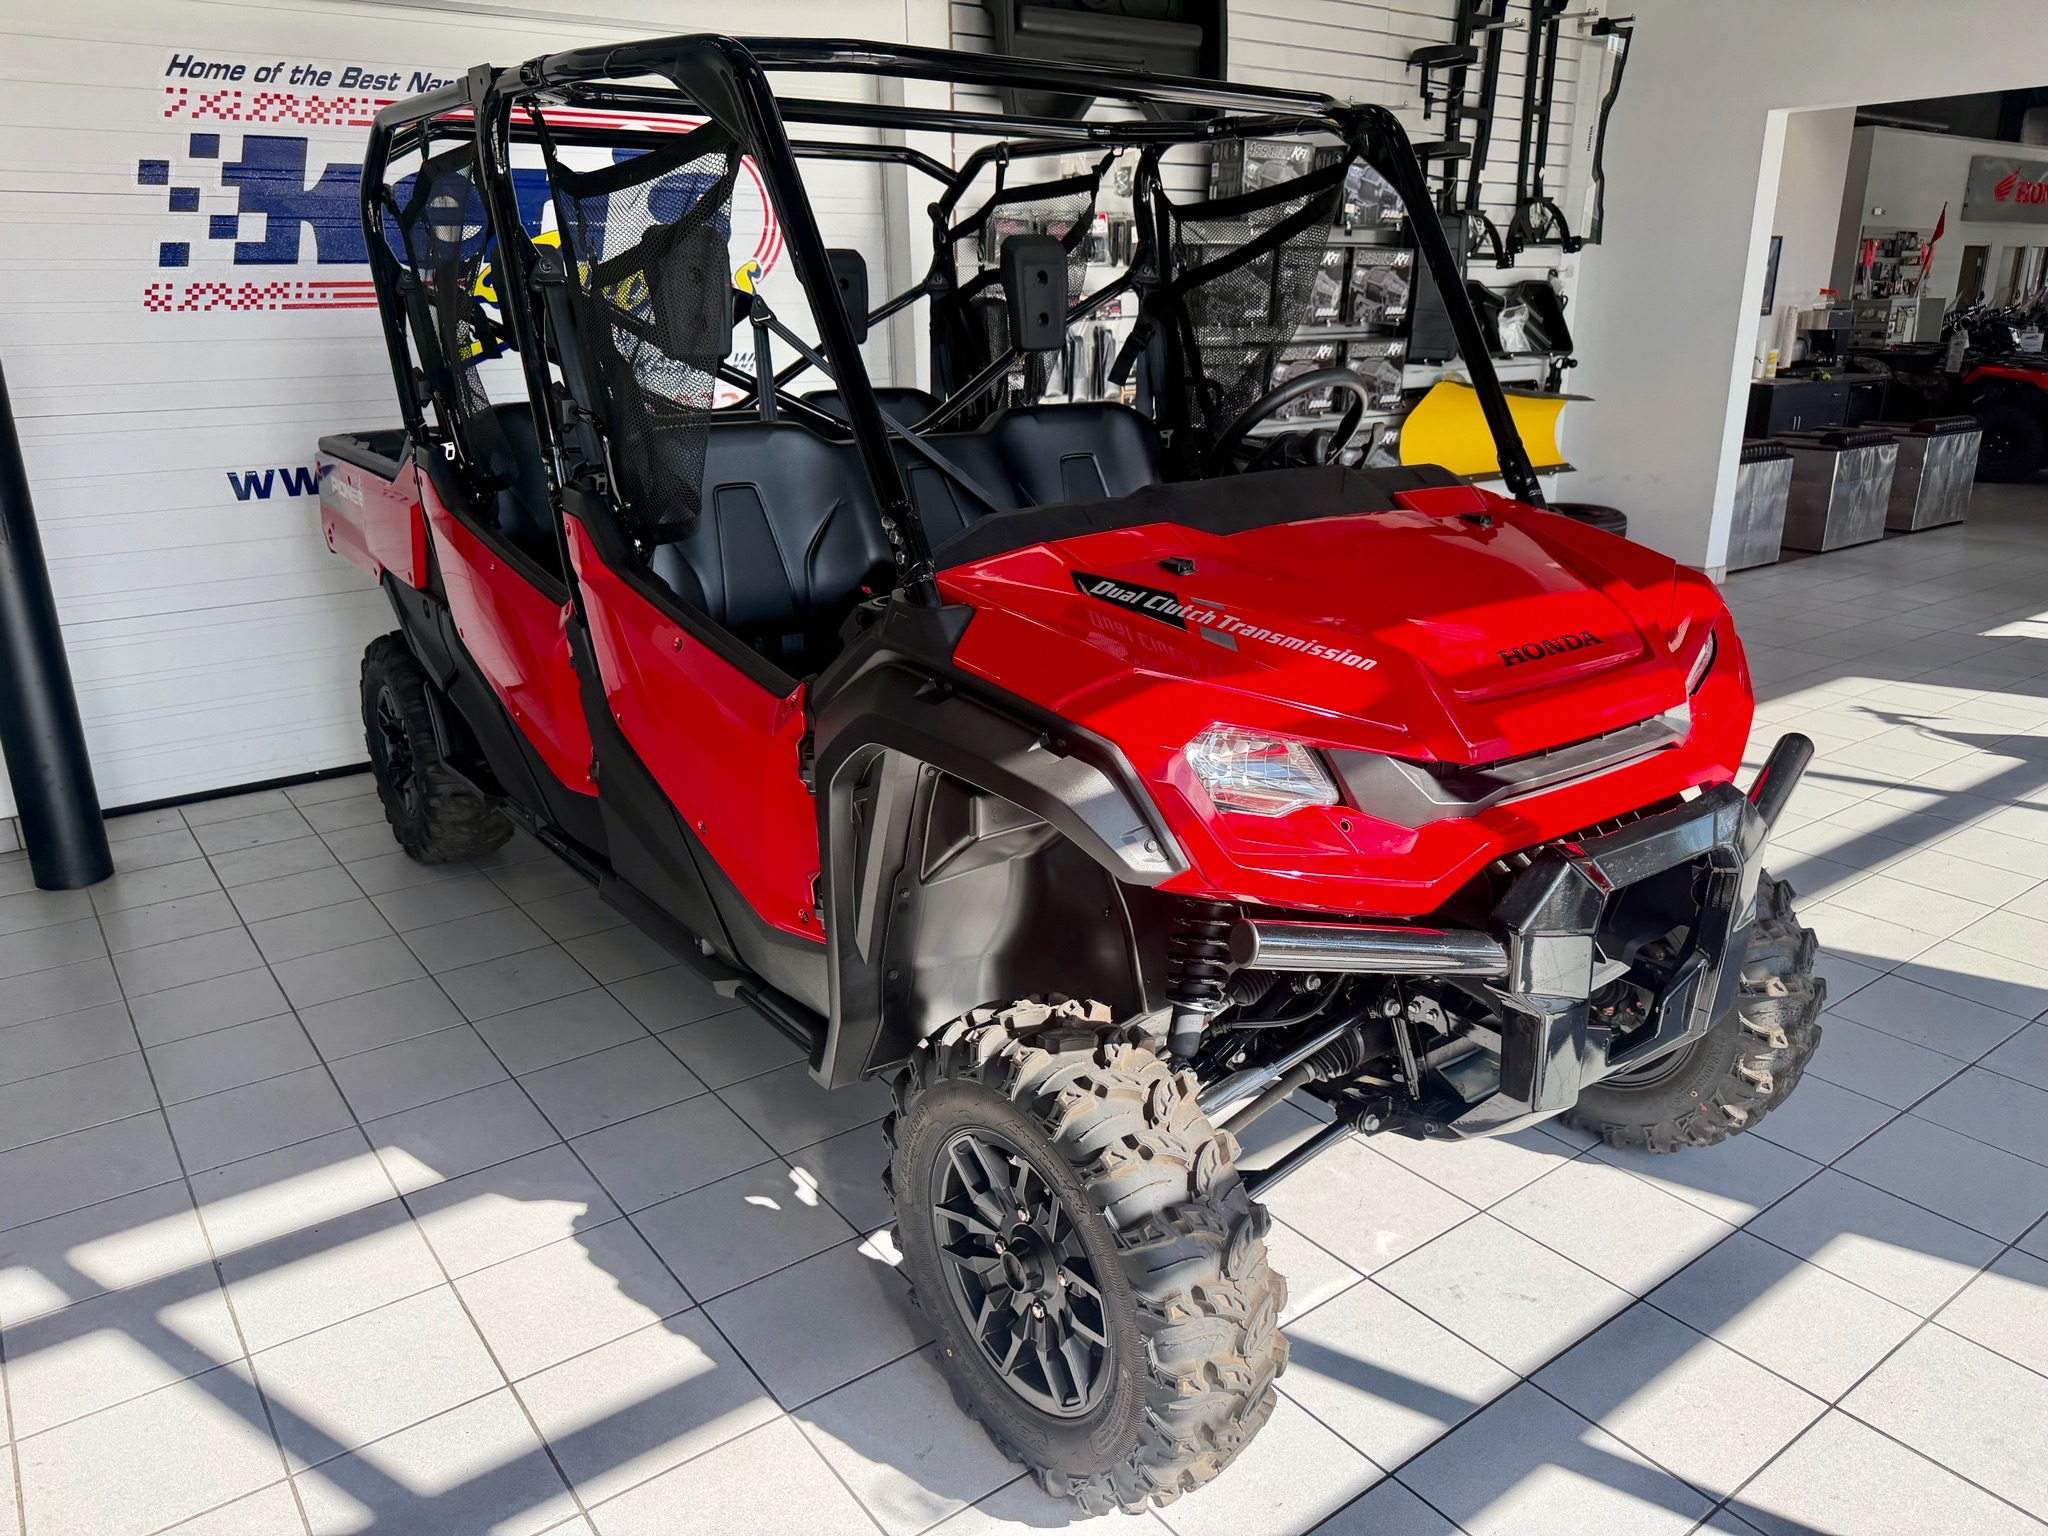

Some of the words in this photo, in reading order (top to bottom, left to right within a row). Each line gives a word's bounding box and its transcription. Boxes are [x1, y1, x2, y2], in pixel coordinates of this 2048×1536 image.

[164, 53, 247, 82] Home
[253, 61, 285, 84] of
[290, 64, 333, 88] the
[338, 66, 402, 90] Best
[406, 71, 455, 93] Na
[1247, 141, 1293, 159] ASSAULT
[1291, 145, 1309, 161] KFI
[1323, 250, 1341, 266] KFI
[1394, 251, 1410, 266] KFI
[1316, 344, 1334, 360] KFI
[1387, 341, 1403, 357] KFI
[1382, 429, 1399, 445] KFI
[1089, 580, 1143, 605] Dual
[1143, 594, 1217, 625] Clutch
[1217, 613, 1378, 671] Transmission
[1496, 631, 1604, 667] HONDA
